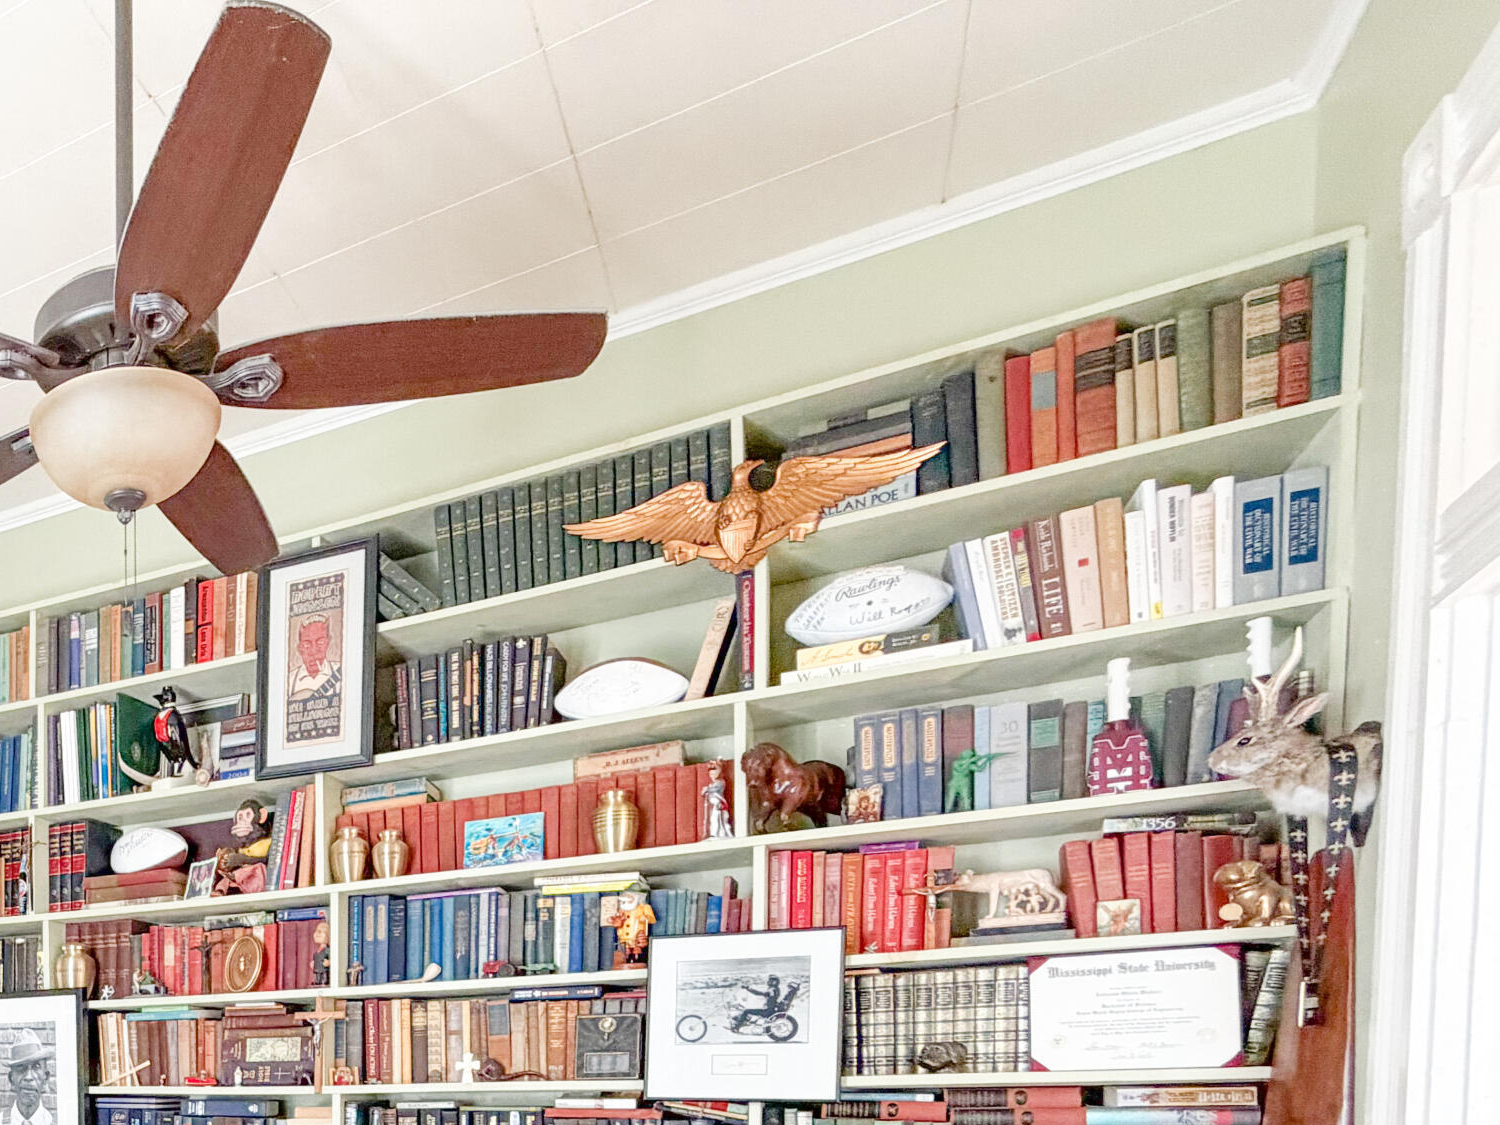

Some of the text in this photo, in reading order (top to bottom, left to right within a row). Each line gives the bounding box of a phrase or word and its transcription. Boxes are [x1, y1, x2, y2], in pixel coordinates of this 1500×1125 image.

[871, 489, 900, 506] POE
[990, 540, 1004, 580] AMBROSE
[999, 537, 1012, 568] STEPHEN
[835, 575, 902, 602] Rawlings
[1006, 583, 1019, 619] CITIZEN
[1042, 577, 1064, 618] LIFE
[1000, 719, 1020, 736] 30
[1047, 959, 1217, 979] Mississippi State University
